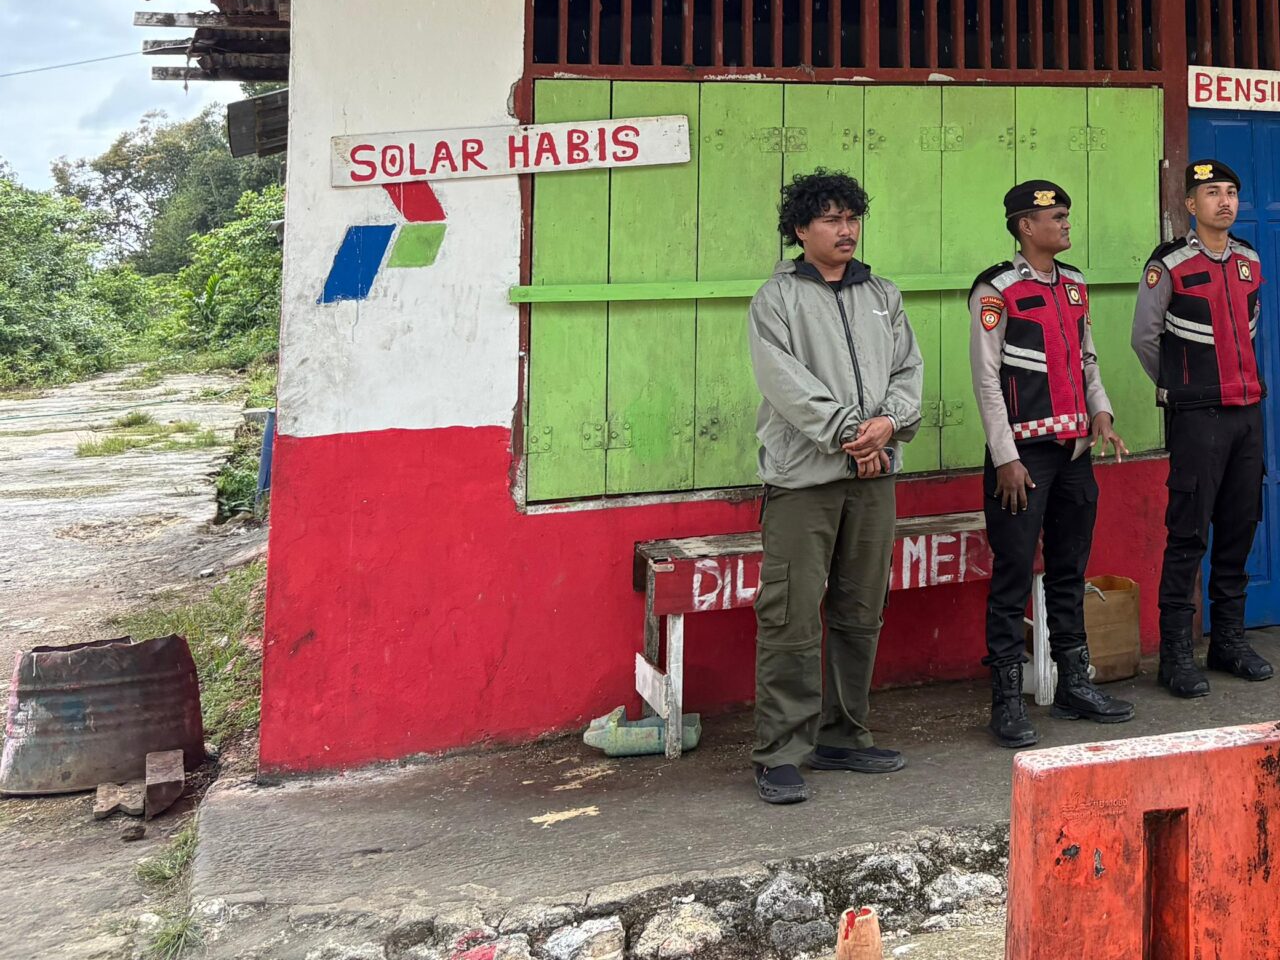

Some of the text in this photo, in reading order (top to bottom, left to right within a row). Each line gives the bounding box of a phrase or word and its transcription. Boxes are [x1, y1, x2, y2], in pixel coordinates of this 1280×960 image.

[350, 125, 641, 182] SOLAR HABIS
[692, 531, 992, 611] DIL MER
